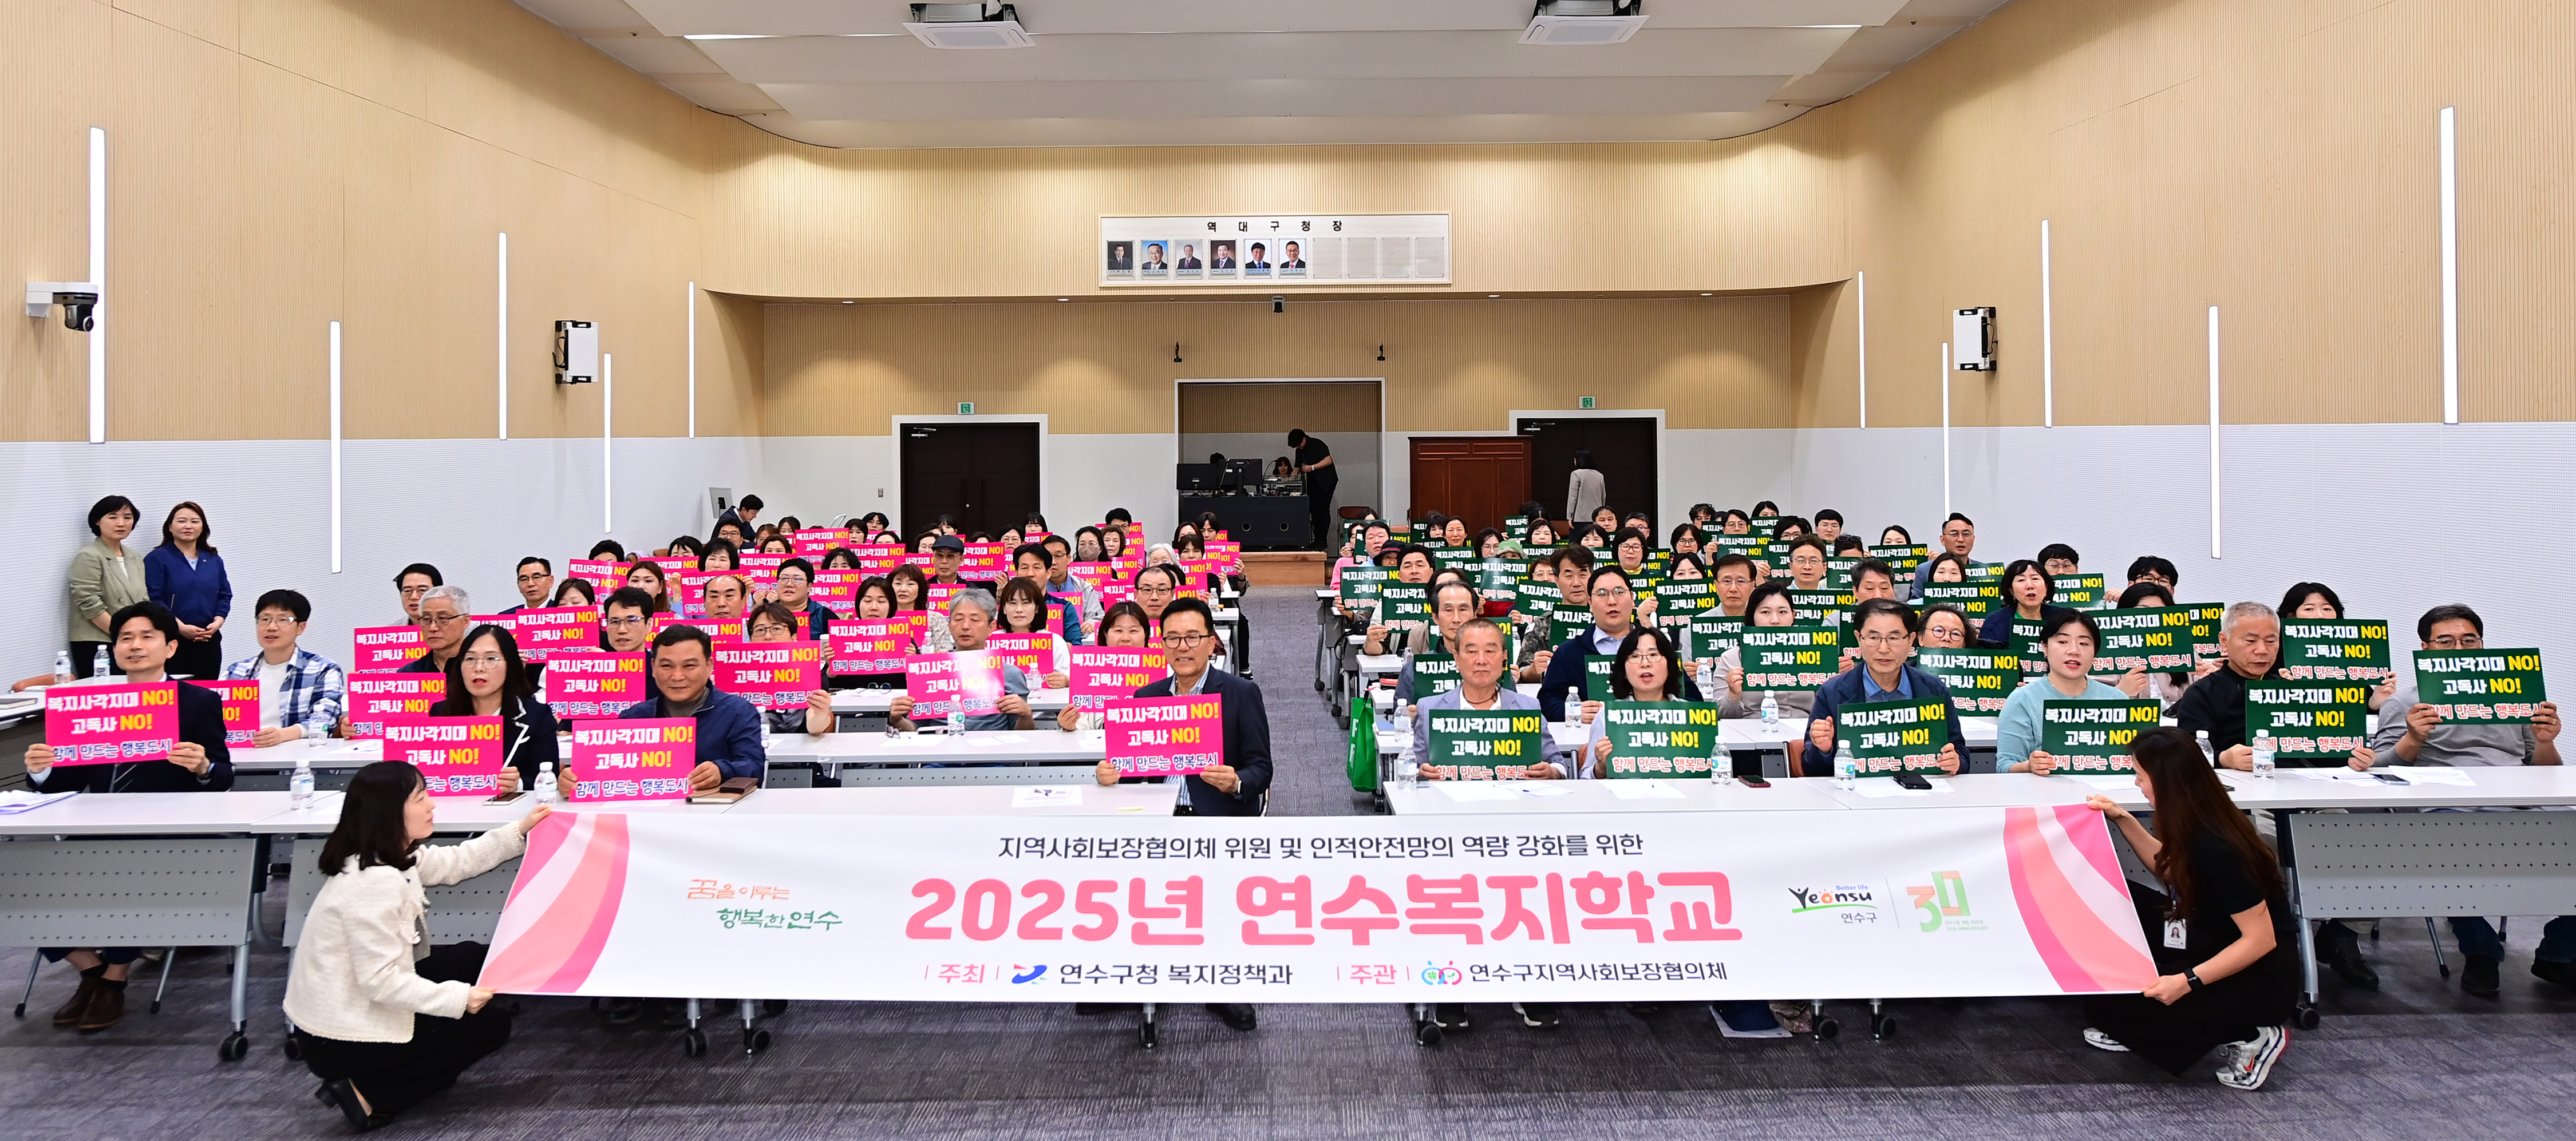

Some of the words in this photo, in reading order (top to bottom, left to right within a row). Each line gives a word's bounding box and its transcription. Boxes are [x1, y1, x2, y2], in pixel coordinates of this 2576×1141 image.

[835, 531, 848, 539] NO!
[890, 548, 904, 556] NO!
[989, 546, 1003, 554] NO!
[1207, 552, 1220, 560] NO!
[1436, 550, 1475, 558] 복지사각지대
[1657, 552, 1669, 560] NO!
[683, 560, 698, 569] NO!
[879, 560, 894, 568] NO!
[979, 558, 994, 566] NO!
[1124, 560, 1137, 568] NO!
[1190, 564, 1206, 572] NO!
[1482, 562, 1527, 572] 복지사각지대
[1648, 562, 1661, 570] NO!
[749, 569, 770, 577] 고독사
[1096, 565, 1111, 574] NO!
[1342, 570, 1387, 580] 복지사각지대
[600, 579, 618, 588] NO!
[842, 574, 858, 583] NO!
[1492, 576, 1515, 585] 고독사
[831, 587, 848, 595] NO!
[1354, 585, 1377, 593] 고독사
[1483, 590, 1495, 598] 함께
[1497, 590, 1516, 599] 만드는
[1396, 604, 1423, 613] 고독사
[1670, 599, 1696, 609] 고독사
[1697, 598, 1714, 608] NO!
[517, 612, 575, 625] 복지사각지대
[577, 611, 596, 623] NO!
[1385, 620, 1400, 629] 함께
[1661, 616, 1675, 625] 함께
[2162, 612, 2189, 627] NO!
[532, 631, 561, 641] 고독사
[563, 628, 583, 639] NO!
[720, 623, 741, 635] NO!
[830, 624, 886, 637] 복지사각지대
[888, 623, 909, 635] NO!
[2285, 624, 2358, 638] 복지사각지대
[2361, 625, 2387, 640] NO!
[356, 631, 417, 645] 복지사각지대
[1743, 632, 1808, 646] 복지사각지대
[2106, 634, 2143, 649] 고독사
[2146, 632, 2172, 647] NO!
[844, 641, 873, 653] 고독사
[875, 640, 895, 652] NO!
[2305, 644, 2342, 659] 고독사
[2345, 644, 2371, 659] NO!
[372, 649, 404, 661] 고독사
[405, 648, 426, 659] NO!
[715, 649, 789, 664] 복지사각지대
[792, 648, 818, 662] NO!
[2150, 654, 2191, 668] 행복도시
[548, 659, 616, 672] 복지사각지대
[618, 659, 643, 672] NO!
[833, 660, 848, 671] 함께
[850, 659, 874, 671] 만드는
[978, 656, 1001, 669] NO!
[1919, 655, 1991, 669] 복지사각지대
[1994, 656, 2018, 669] NO!
[2418, 655, 2505, 672] 복지사각지대
[2508, 655, 2541, 672] NO!
[734, 670, 772, 683] 고독사
[774, 669, 800, 683] NO!
[2291, 666, 2313, 680] 함께
[2316, 665, 2346, 680] 만드는
[350, 680, 419, 694] 복지사각지대
[421, 680, 445, 693] NO!
[563, 680, 599, 692] 고독사
[600, 679, 626, 692] NO!
[1977, 675, 2001, 689] NO!
[2443, 679, 2487, 695] 고독사
[2490, 678, 2521, 694] NO!
[47, 692, 138, 711] 복지사각지대
[141, 689, 174, 706] NO!
[232, 686, 258, 700] NO!
[2249, 688, 2332, 704] 복지사각지대
[2336, 688, 2364, 703] NO!
[368, 700, 402, 714] 고독사
[405, 699, 429, 712] NO!
[571, 703, 599, 714] 만드는
[1107, 706, 1187, 723] 복지사각지대
[1190, 702, 1219, 719] NO!
[2456, 704, 2492, 718] 만드는
[1607, 710, 1686, 724] 복지사각지대
[1689, 709, 1716, 725] NO!
[1840, 707, 1917, 727] 복지사각지대
[1919, 704, 1945, 721] NO!
[2045, 708, 2126, 723] 복지사각지대
[2129, 707, 2158, 722] NO!
[2270, 711, 2313, 727] 고독사
[2316, 711, 2344, 727] NO!
[71, 719, 117, 734] 고독사
[120, 714, 152, 730] NO!
[1432, 718, 1510, 733] 복지사각지대
[1512, 716, 1539, 732] NO!
[385, 726, 467, 741] 복지사각지대
[470, 724, 500, 740] NO!
[575, 728, 660, 745] 복지사각지대
[663, 726, 693, 743] NO!
[1128, 730, 1168, 746] 고독사
[1171, 727, 1200, 743] NO!
[1628, 732, 1669, 747] 고독사
[1671, 731, 1698, 748] NO!
[1860, 732, 1899, 748] 고독사
[1902, 729, 1929, 745] NO!
[2064, 730, 2106, 745] 고독사
[80, 742, 118, 759] 만드는
[1451, 740, 1491, 755] 고독사
[1494, 739, 1521, 755] NO!
[2279, 736, 2316, 752] 만드는
[405, 750, 447, 765] 고독사
[449, 748, 479, 764] NO!
[595, 753, 638, 769] 고독사
[641, 751, 671, 767] NO!
[1612, 756, 1635, 771] 함께
[1638, 756, 1672, 771] 만드는
[1868, 755, 1901, 772] 만드는
[2072, 755, 2108, 770] 만드는
[1460, 765, 1493, 779] 만드는
[603, 779, 638, 795] 만드는
[999, 838, 1215, 858] 지역사회보장협의체
[1225, 838, 1270, 858] 위원
[1281, 838, 1301, 858] 및
[1311, 837, 1453, 858] 인적안전망의
[1463, 837, 1509, 857] 역량
[1517, 835, 1588, 856] 강화를
[1597, 834, 1643, 855] 위한
[688, 879, 735, 899] 꿈을
[740, 885, 790, 900] 이루는
[1788, 886, 1872, 910] Yeonsu
[906, 875, 1204, 945] 2025년
[1236, 870, 1743, 945] 연수복지학교
[717, 908, 785, 929] 행복한
[787, 910, 843, 930] 연수
[1841, 913, 1878, 924] 연수구
[939, 964, 985, 984] 주최
[1061, 965, 1157, 984] 연수구청
[1169, 965, 1292, 984] 복지정책과
[1351, 965, 1397, 984] 주관
[1470, 963, 1726, 982] 연수구지역사회보장협의체
